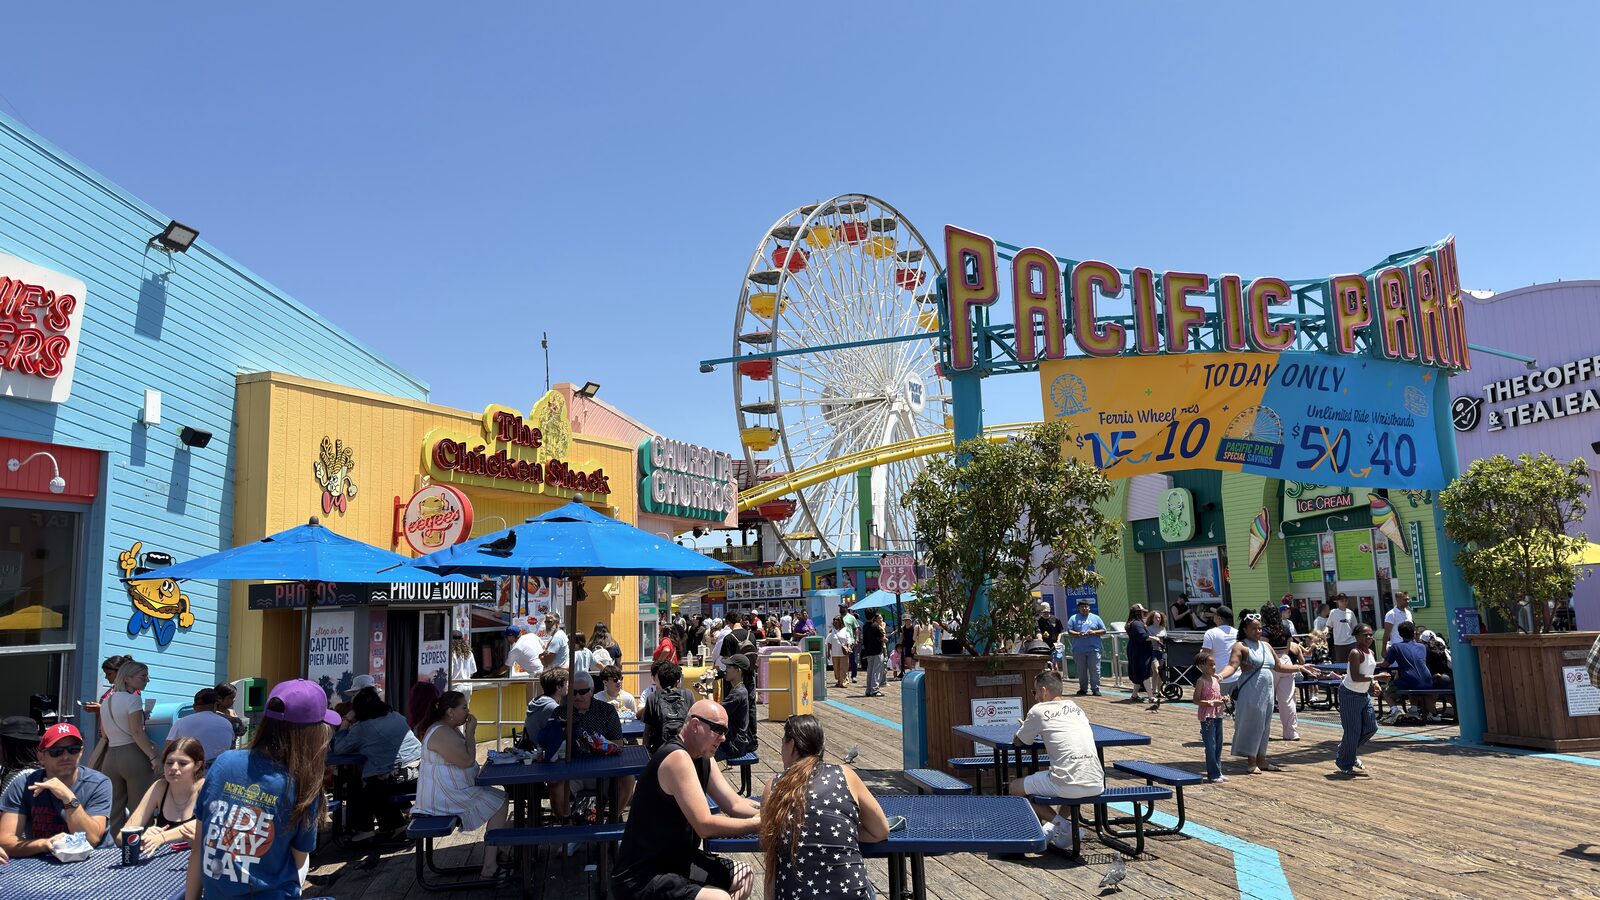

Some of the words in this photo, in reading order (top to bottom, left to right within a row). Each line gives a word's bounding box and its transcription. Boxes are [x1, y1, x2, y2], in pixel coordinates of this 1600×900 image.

[944, 223, 1296, 371] PACIFIC
[1328, 233, 1472, 374] PARK
[1203, 362, 1279, 390] TODAY
[1280, 363, 1346, 393] ONLY
[1482, 375, 1526, 404] THE
[1098, 410, 1134, 425] Ferris
[1137, 407, 1177, 424] Wheel
[1306, 404, 1353, 423] Unlimited
[1353, 409, 1370, 424] Ride
[1371, 412, 1415, 429] Wristbands
[1487, 411, 1503, 432] &
[493, 410, 543, 448] The
[1222, 451, 1246, 462] SPECIAL
[1246, 453, 1273, 466] SAVINGS
[1225, 442, 1254, 454] PACIFIC
[1253, 444, 1275, 457] PARK
[1366, 430, 1418, 478] $40
[431, 438, 544, 485] Chicken
[544, 458, 612, 495] Shack
[651, 468, 735, 514] CHURROS
[1297, 500, 1314, 512] ICE
[1315, 494, 1351, 510] CREAM
[884, 557, 910, 566] ROUTE
[390, 581, 431, 600] PHOTO
[442, 581, 480, 600] BOOTH
[886, 574, 910, 590] 66
[275, 581, 338, 607] PHOOS
[309, 636, 350, 652] CAPTURE
[309, 653, 325, 666] PIER
[326, 652, 350, 666] MAGIC
[421, 650, 447, 666] EXPRESS
[1043, 710, 1062, 722] San
[259, 792, 279, 806] PARK
[210, 799, 275, 838] RIDE
[204, 823, 267, 856] PLAY
[202, 845, 261, 884] EAT
